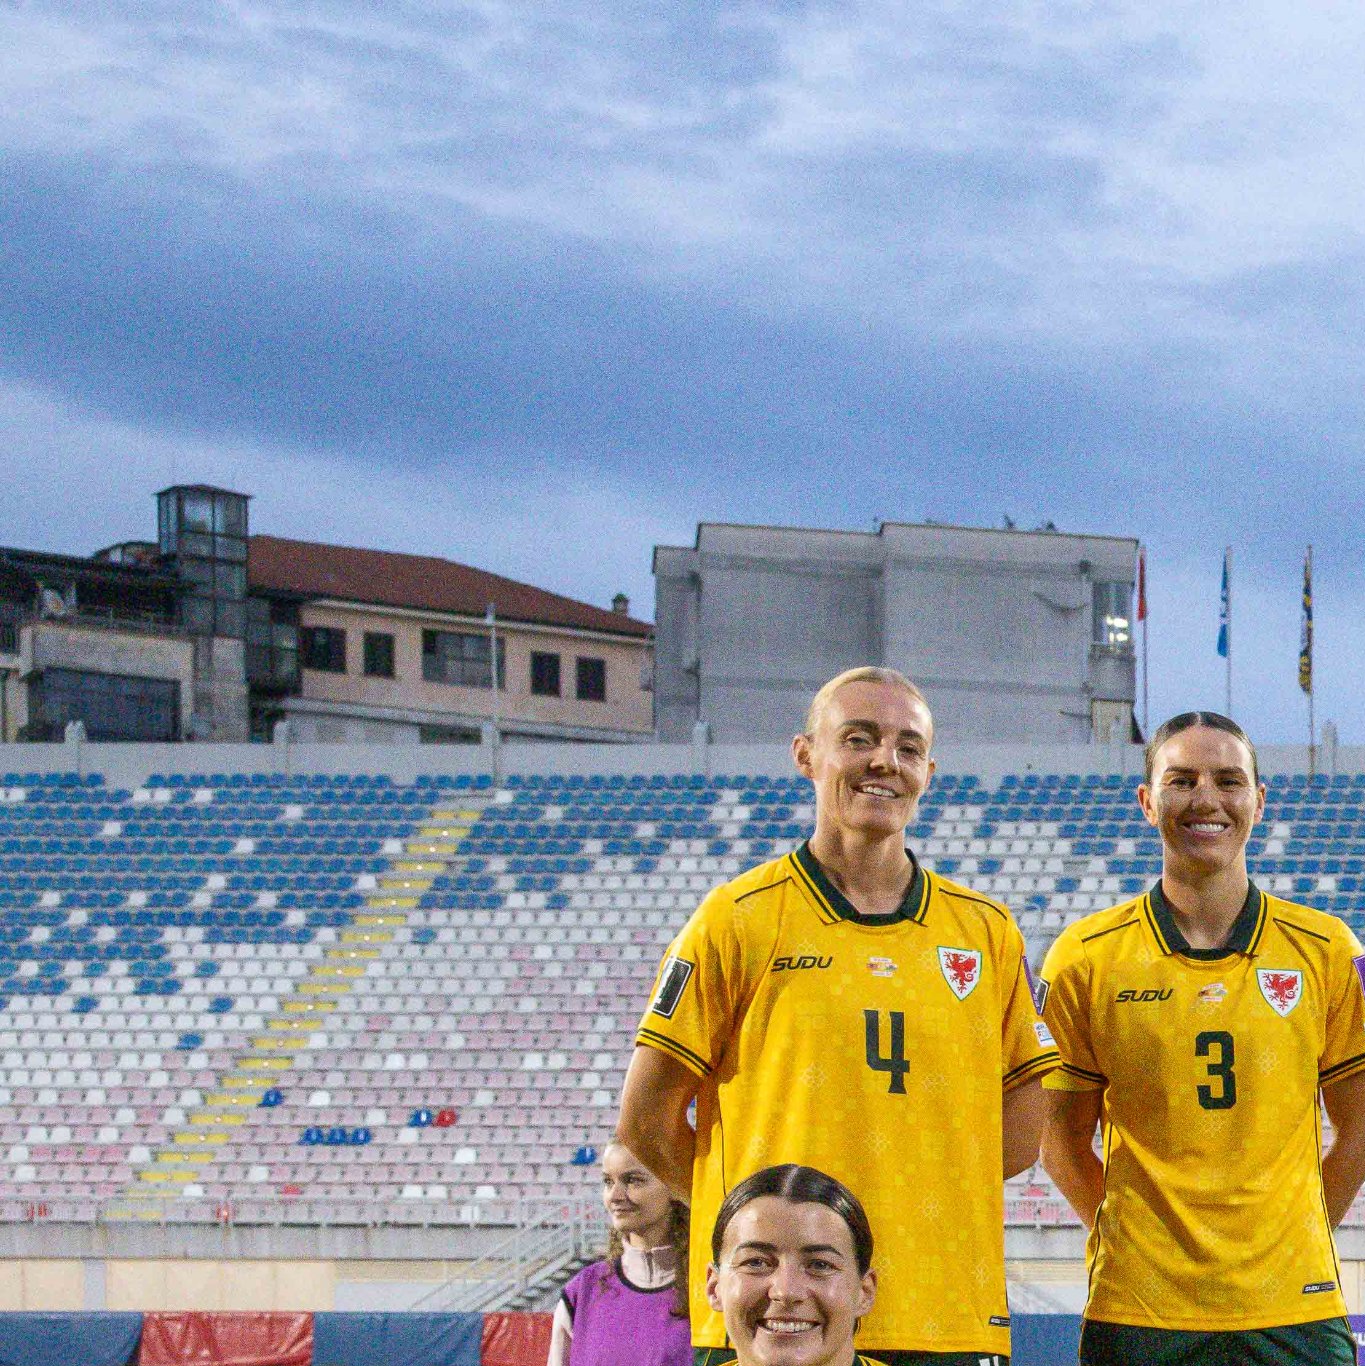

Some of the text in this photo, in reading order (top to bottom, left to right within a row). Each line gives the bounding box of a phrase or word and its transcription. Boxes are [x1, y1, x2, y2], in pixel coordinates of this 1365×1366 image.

[771, 955, 833, 973] SUDU
[1115, 988, 1174, 1003] SUDU
[864, 1010, 909, 1095] 4
[1194, 1031, 1237, 1110] 3
